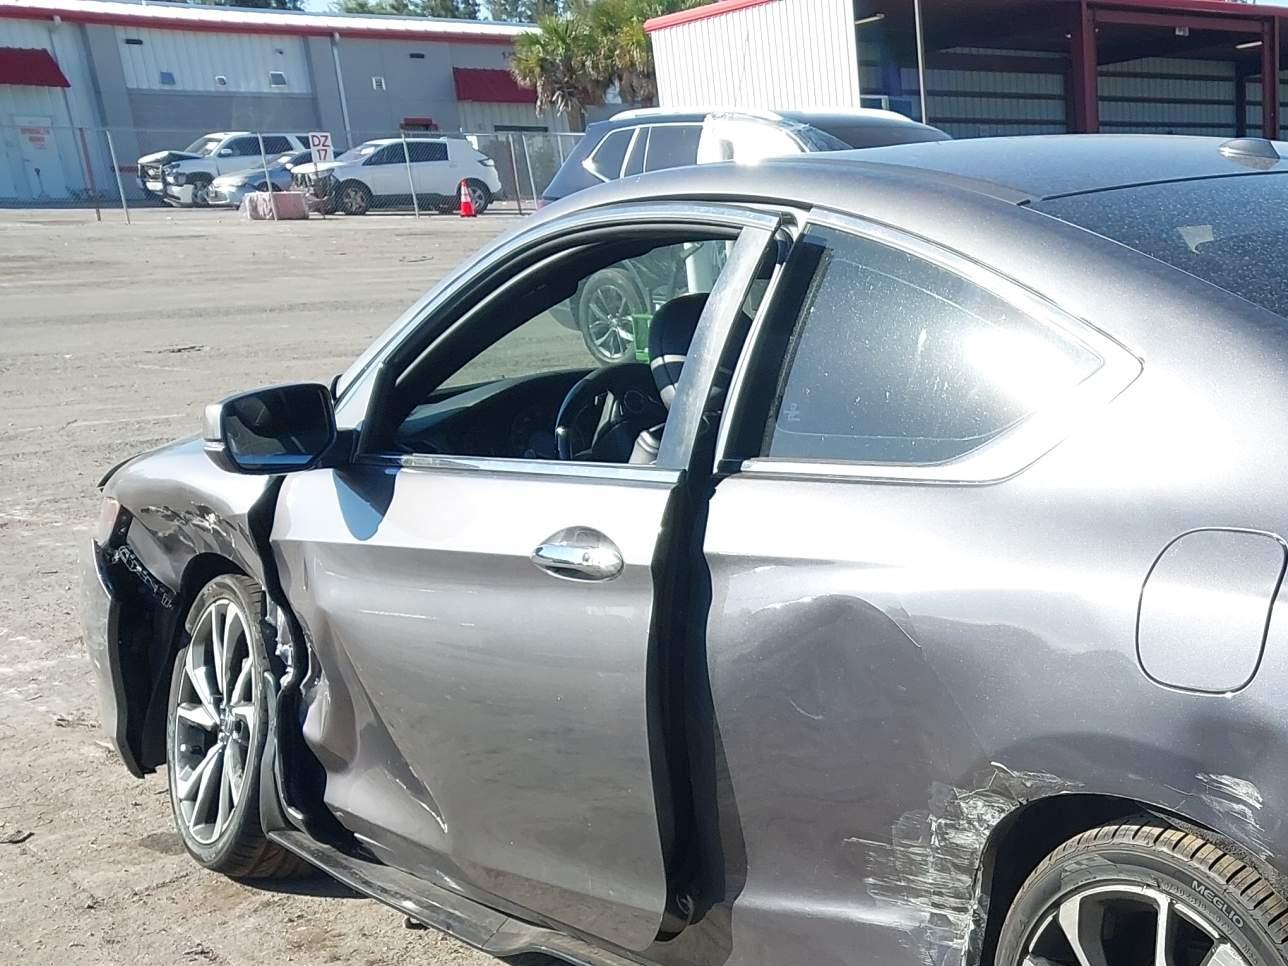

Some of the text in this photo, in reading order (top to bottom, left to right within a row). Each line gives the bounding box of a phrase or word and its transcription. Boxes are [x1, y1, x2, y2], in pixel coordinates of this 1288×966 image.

[311, 134, 331, 147] DZ
[317, 148, 328, 161] 17
[1191, 880, 1245, 929] MEGLIO
